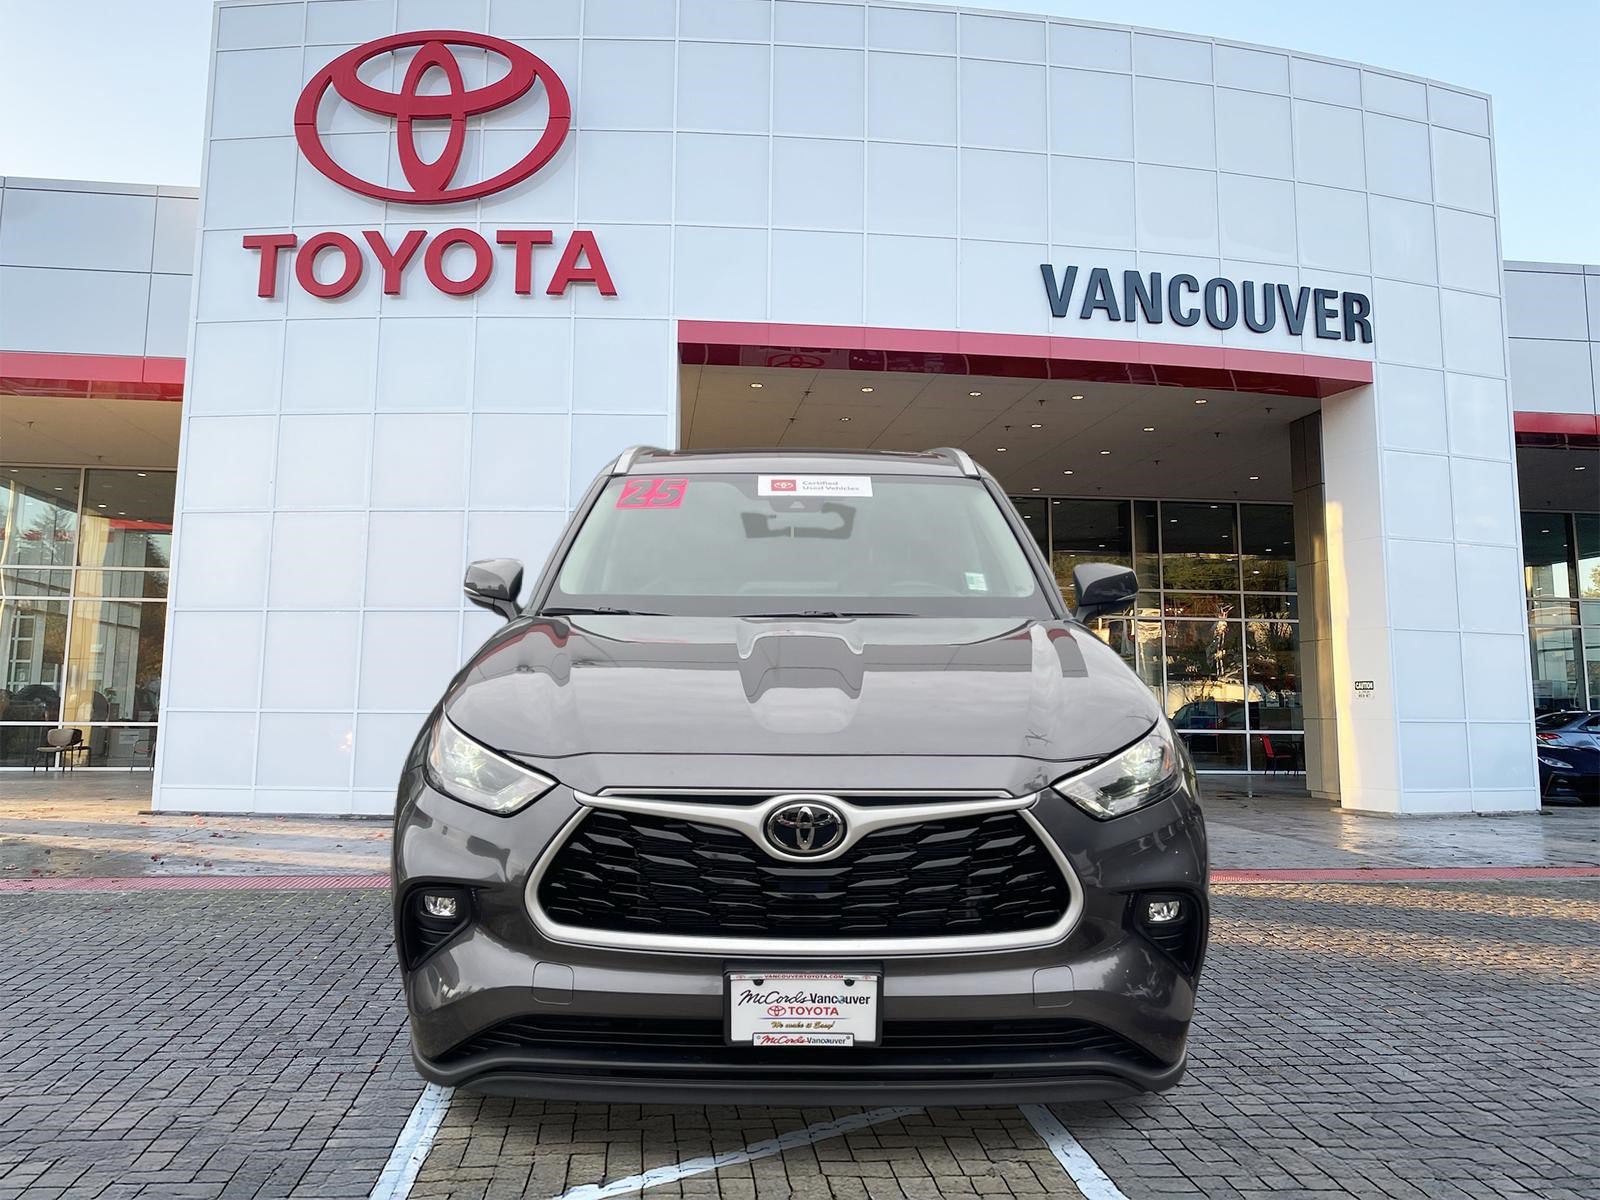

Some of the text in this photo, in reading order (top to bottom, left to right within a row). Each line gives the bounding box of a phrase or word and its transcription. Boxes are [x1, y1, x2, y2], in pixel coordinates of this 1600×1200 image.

[242, 228, 617, 299] TOYOTA
[1040, 264, 1373, 343] VANCOUVER
[620, 478, 688, 505] 25
[809, 992, 870, 1005] Vancouver
[788, 1007, 839, 1016] TOYOTA
[807, 1037, 846, 1045] Vancouver
